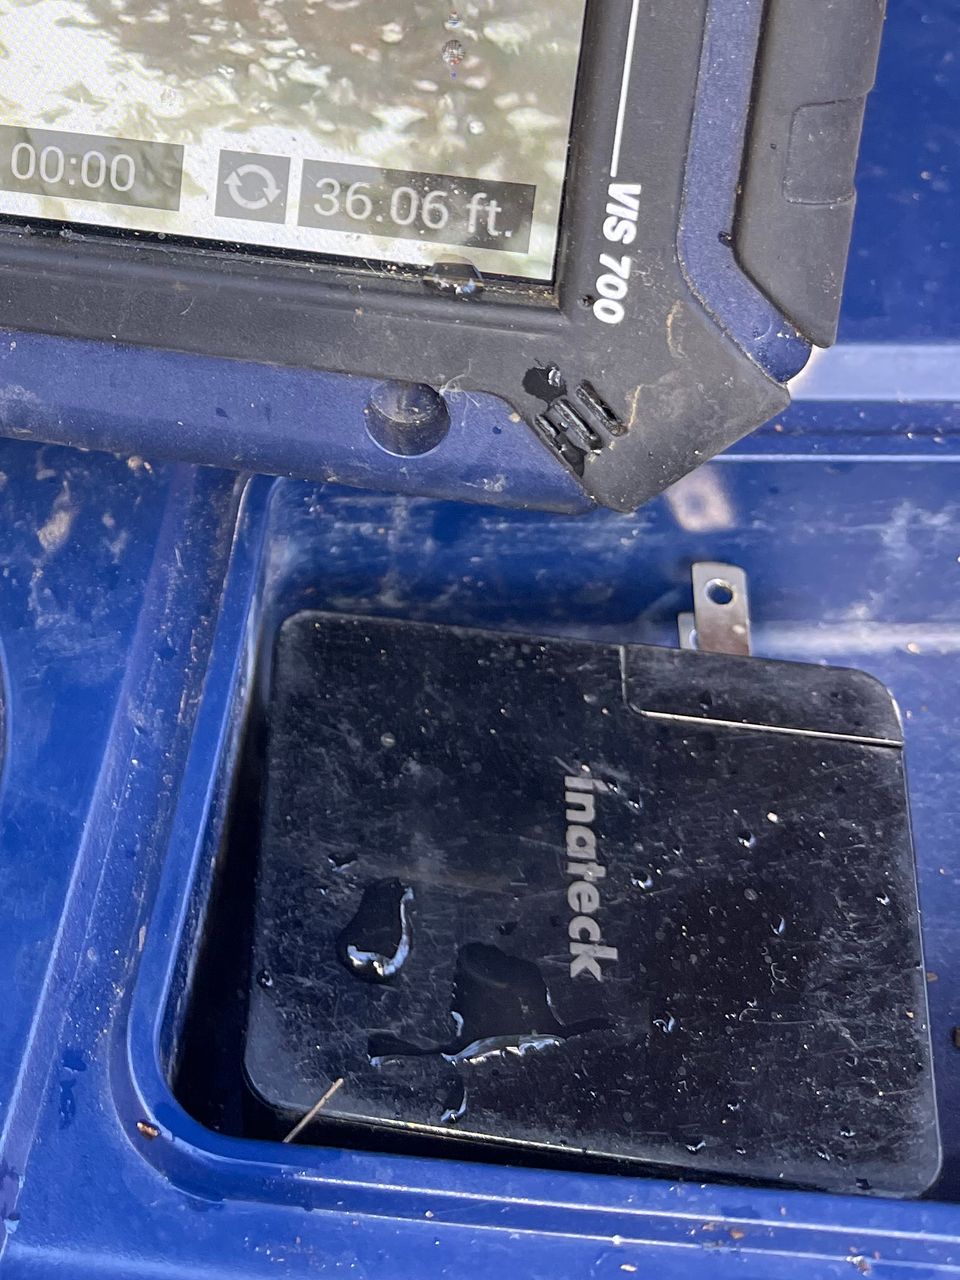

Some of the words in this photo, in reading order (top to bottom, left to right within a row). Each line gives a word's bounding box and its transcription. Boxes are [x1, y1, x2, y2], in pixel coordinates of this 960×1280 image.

[10, 142, 136, 192] 00:00
[313, 177, 449, 230] 36.06
[466, 192, 512, 238] ft.
[602, 183, 642, 245] VIS
[592, 253, 632, 325] 700
[564, 774, 619, 982] inateck
